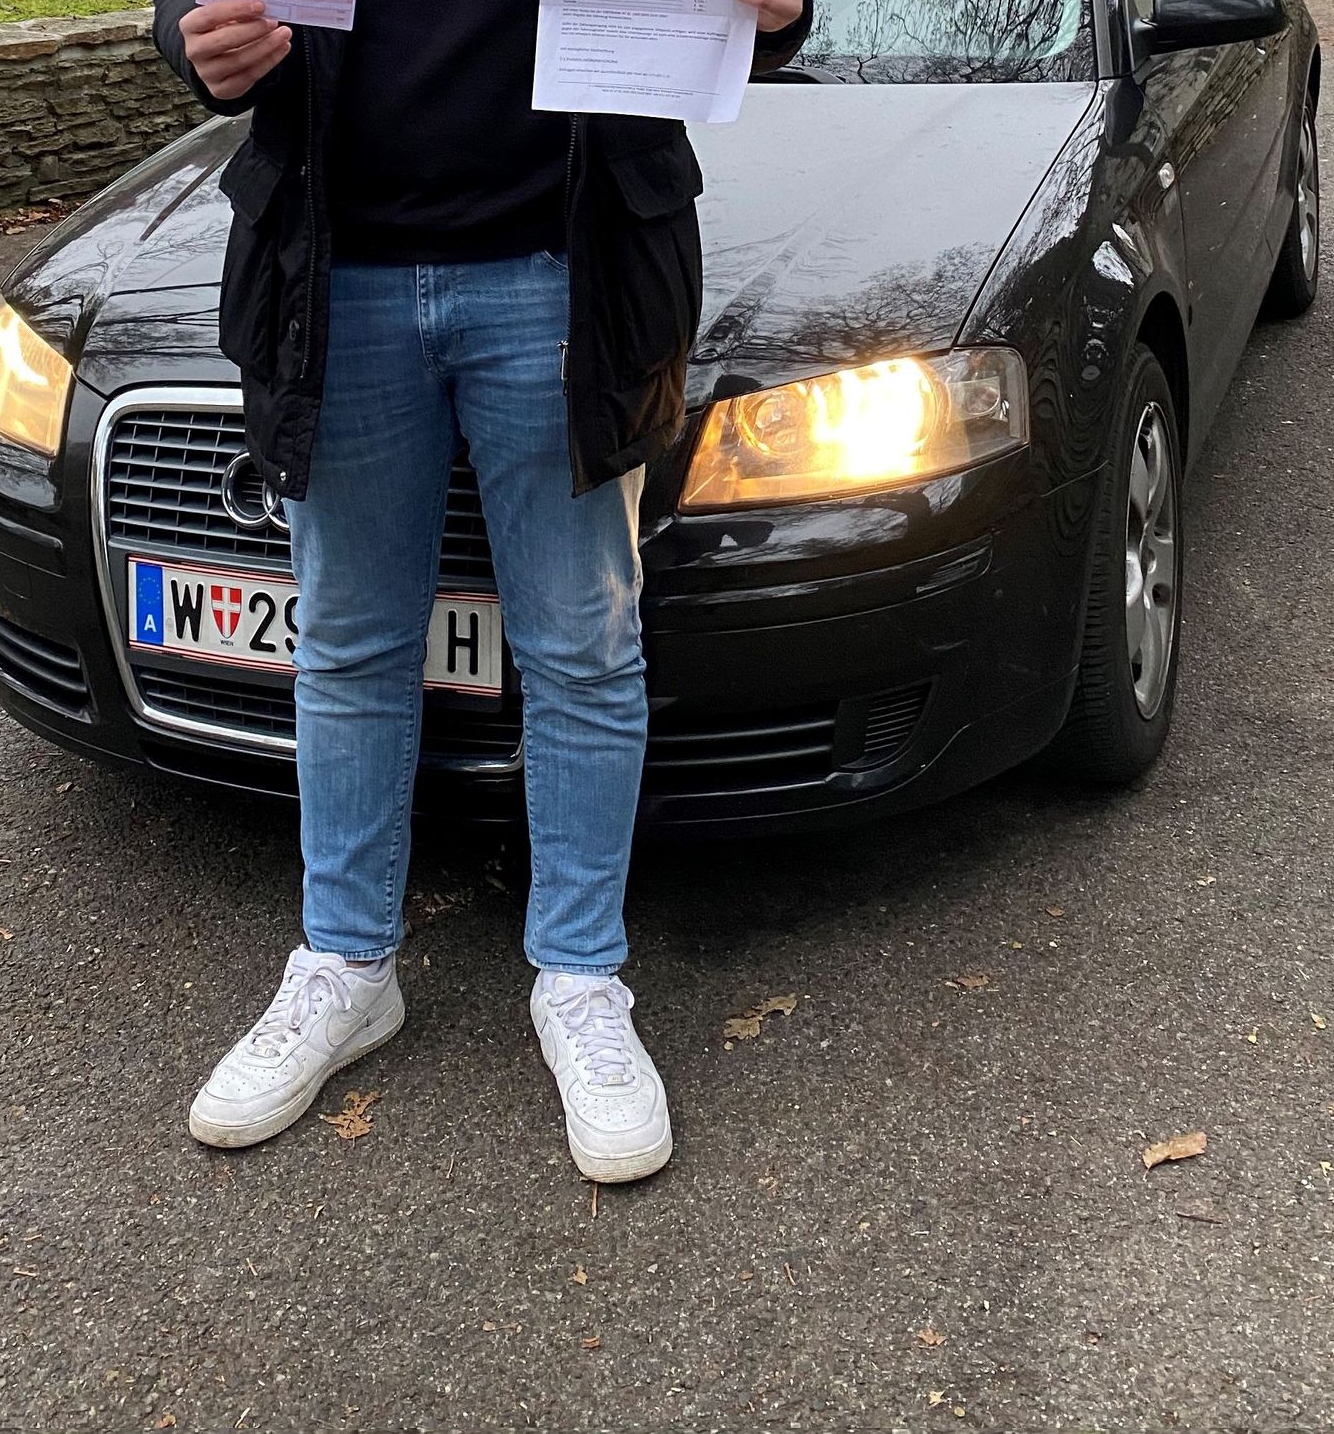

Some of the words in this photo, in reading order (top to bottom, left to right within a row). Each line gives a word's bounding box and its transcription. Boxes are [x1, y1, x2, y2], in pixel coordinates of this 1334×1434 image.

[144, 614, 157, 633] A
[170, 579, 204, 642] W
[447, 610, 479, 676] H
